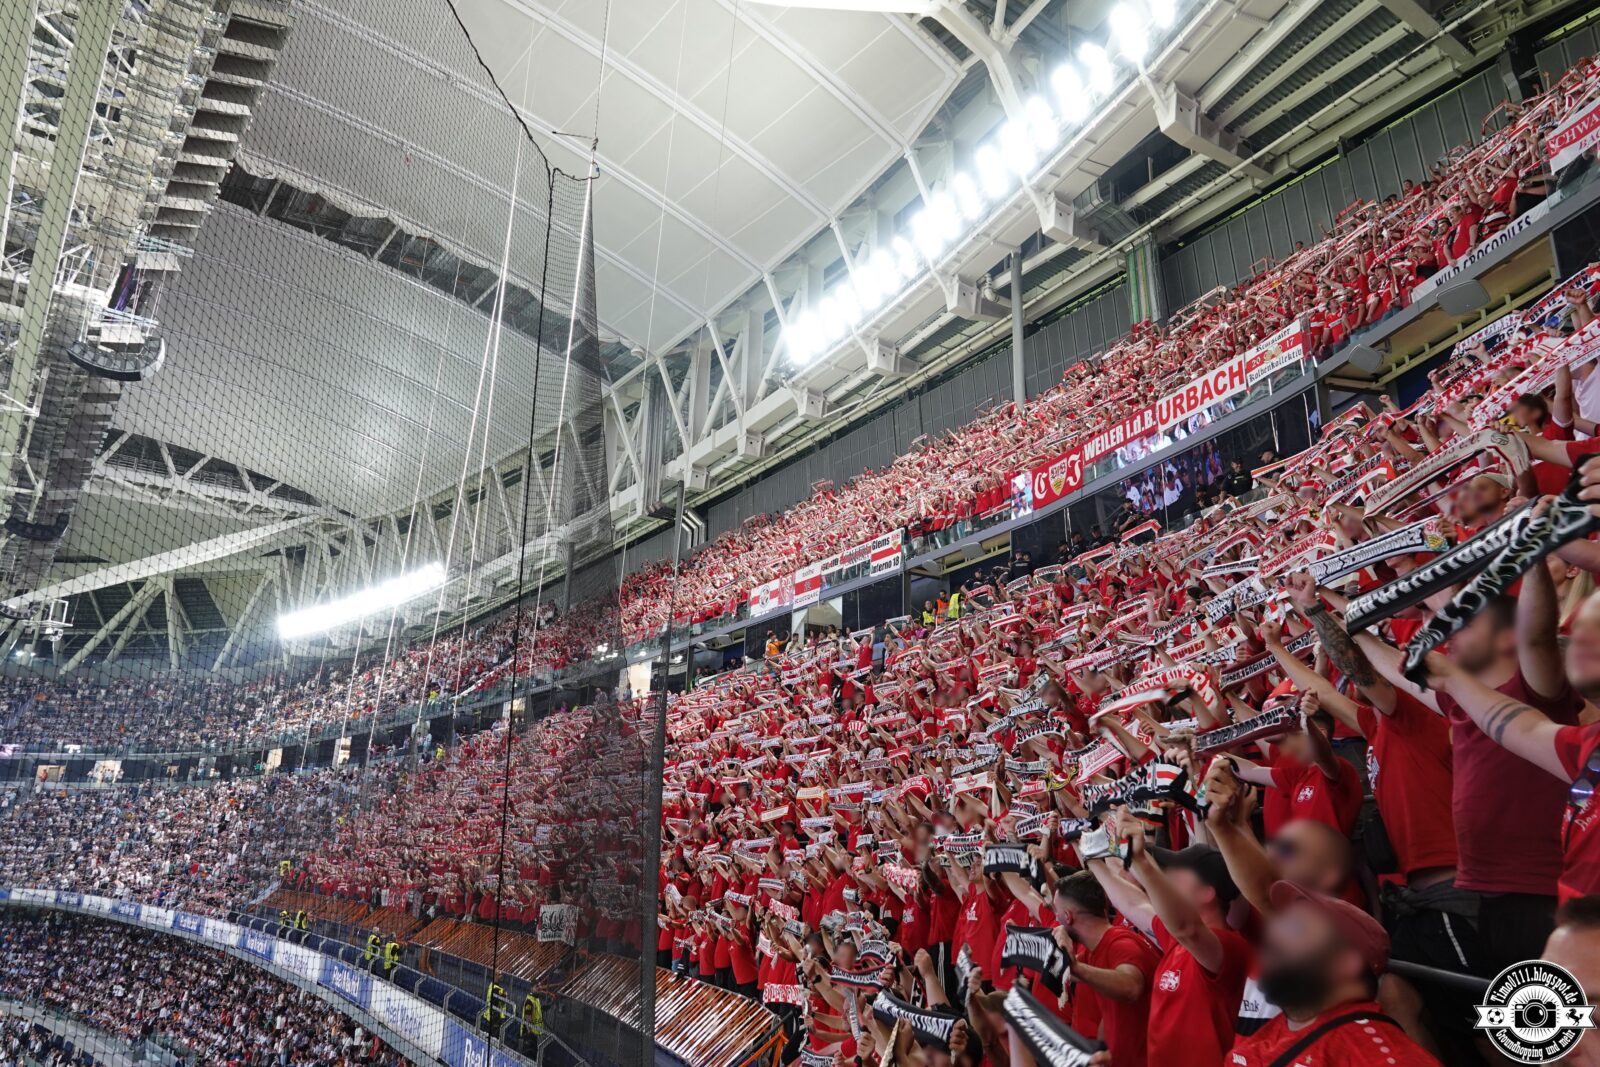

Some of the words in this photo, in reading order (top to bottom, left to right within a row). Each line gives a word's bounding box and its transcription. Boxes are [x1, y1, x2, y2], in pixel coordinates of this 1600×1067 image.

[1158, 360, 1245, 426] URBACH
[1084, 424, 1124, 461] WEILER
[1125, 409, 1156, 439] i.d.B.
[871, 535, 891, 550] Glems
